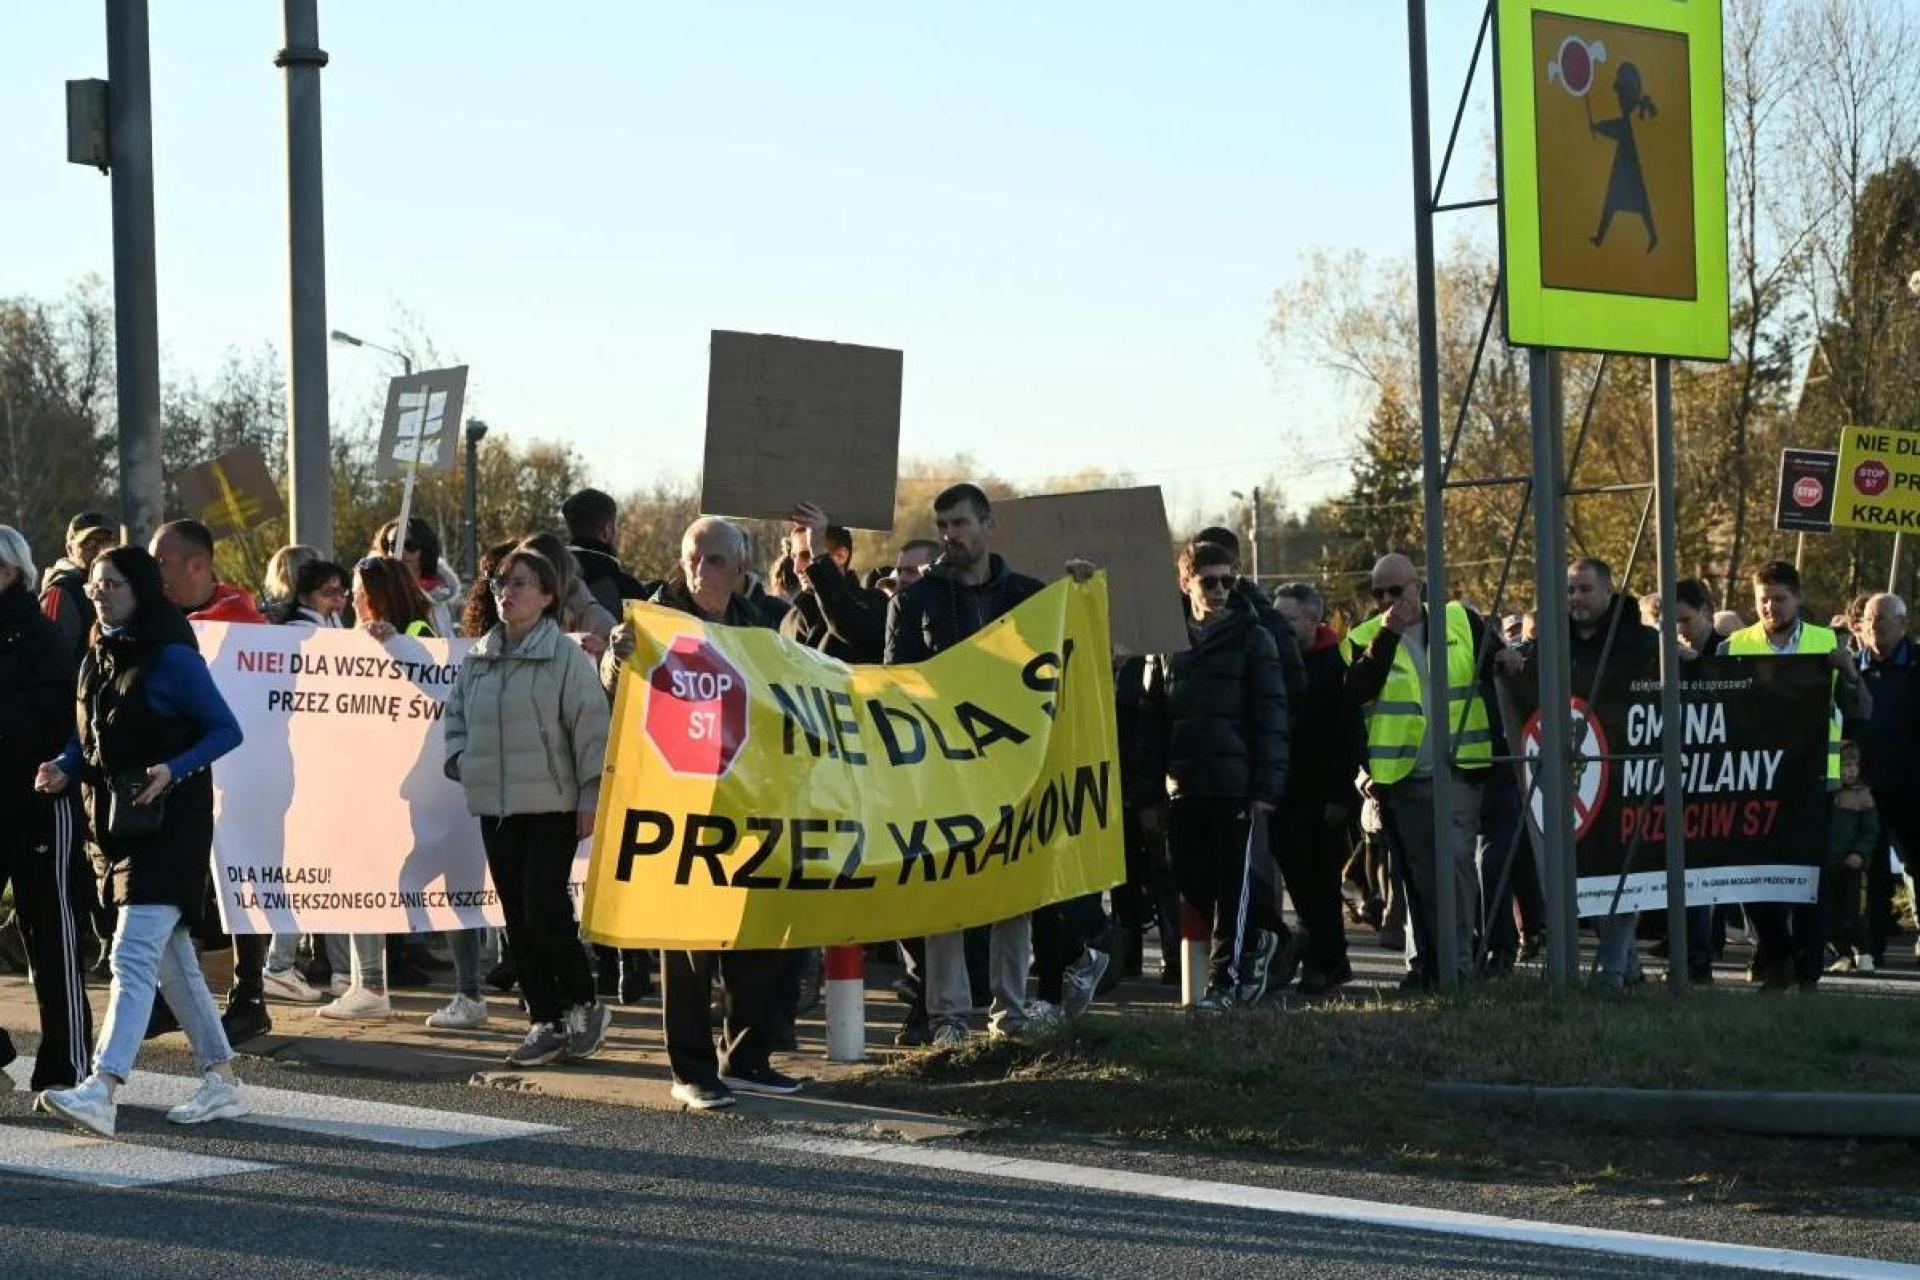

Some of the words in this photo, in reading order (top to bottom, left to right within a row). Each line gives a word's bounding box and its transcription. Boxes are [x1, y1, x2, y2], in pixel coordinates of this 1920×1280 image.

[1856, 433, 1890, 453] NIE
[237, 650, 283, 673] NIE!
[290, 653, 329, 676] DLA
[334, 656, 461, 685] WSZYSTKICH
[671, 669, 732, 699] STOP
[268, 690, 330, 714] PRZEZ
[335, 693, 402, 722] GMINĘ
[407, 694, 448, 721] ŚW
[688, 711, 717, 740] S7
[768, 683, 868, 766] NIE
[866, 700, 1032, 767] DLA
[1627, 702, 1727, 746] GMNA
[1620, 801, 1736, 843] PRZCIW
[1742, 799, 1779, 836] S7
[615, 808, 877, 890] PRZEZ
[227, 866, 257, 884] DLA
[262, 866, 331, 884] HAŁASU!
[262, 891, 387, 914] ZWIĘKSZONEGO
[390, 890, 500, 908] ZANIECZYSZCZE
